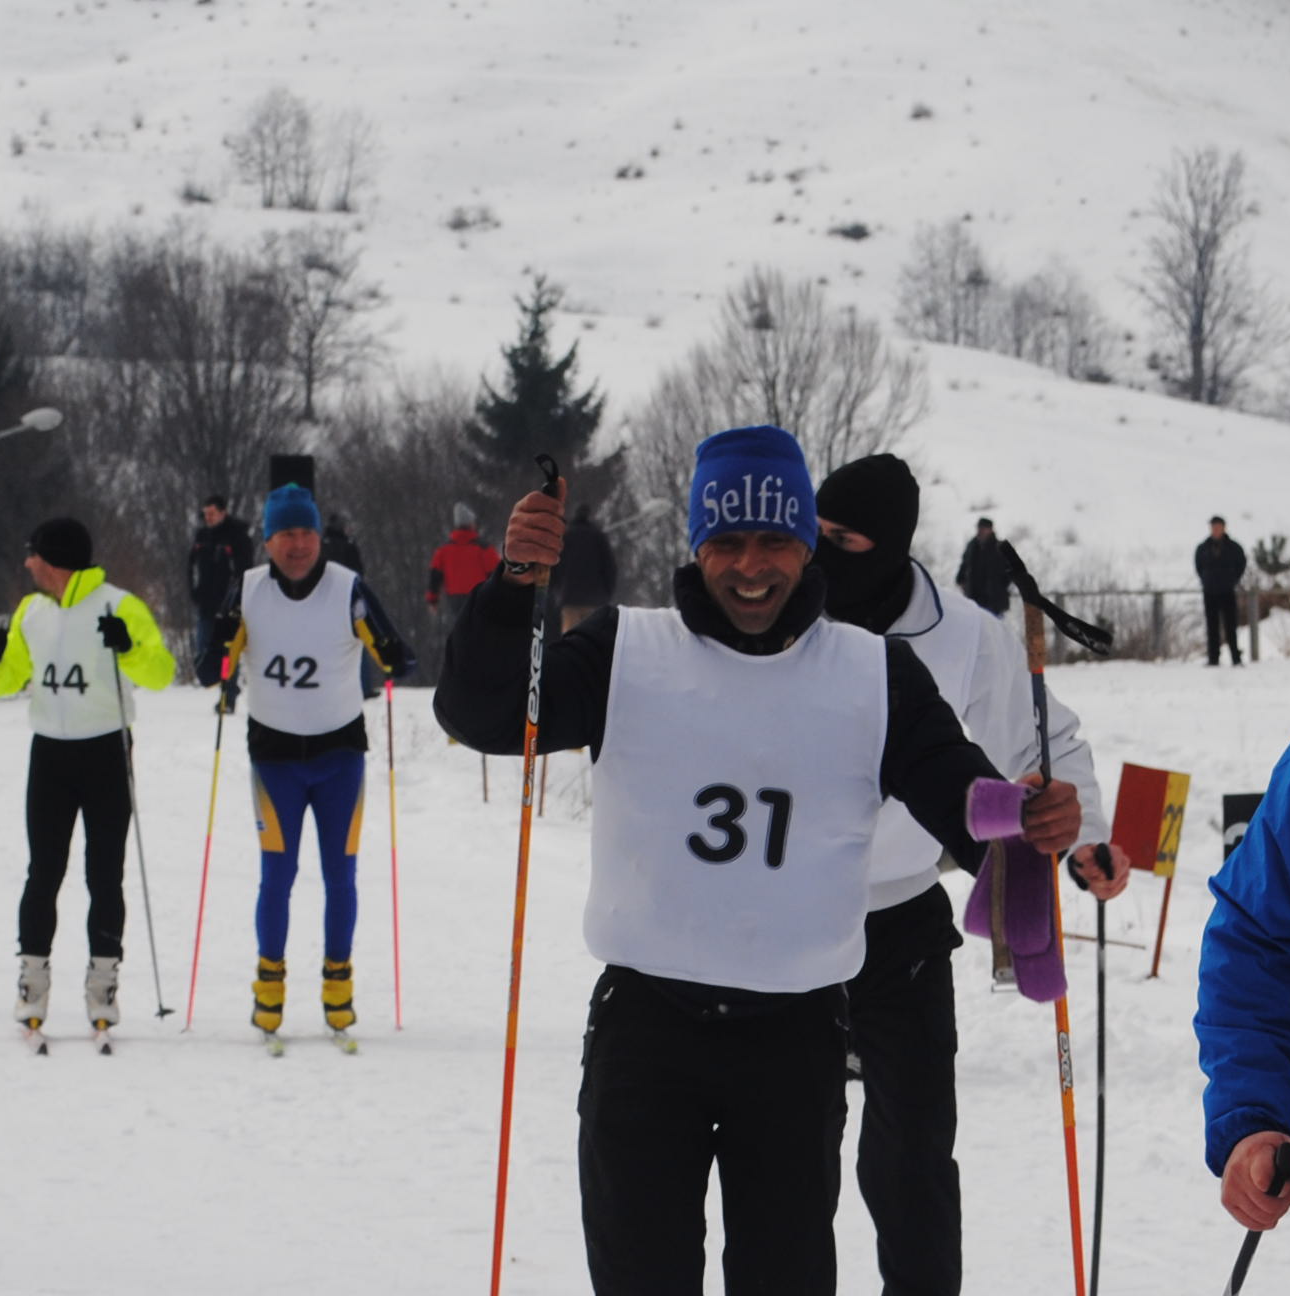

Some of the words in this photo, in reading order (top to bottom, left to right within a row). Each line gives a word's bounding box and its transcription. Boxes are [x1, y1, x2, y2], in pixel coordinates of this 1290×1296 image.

[702, 474, 799, 528] Selfie
[42, 662, 88, 694] 44
[264, 654, 320, 689] 42
[686, 783, 793, 870] 31
